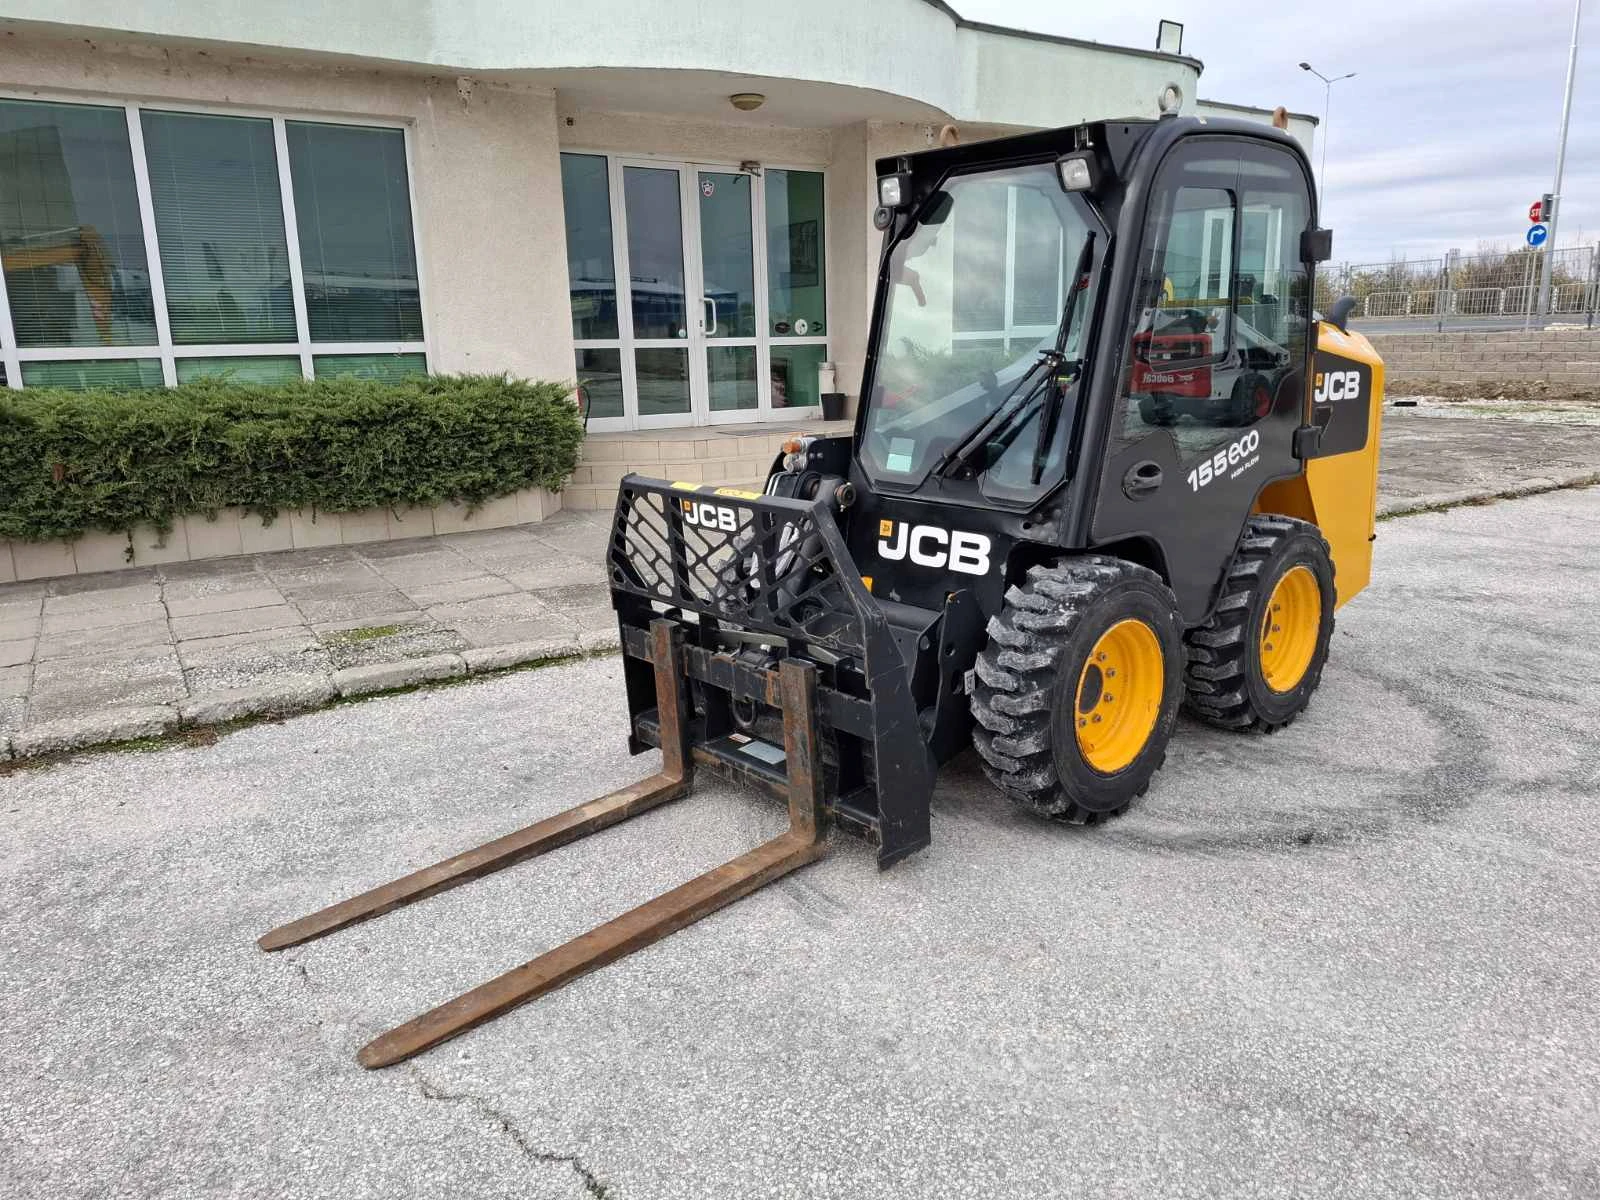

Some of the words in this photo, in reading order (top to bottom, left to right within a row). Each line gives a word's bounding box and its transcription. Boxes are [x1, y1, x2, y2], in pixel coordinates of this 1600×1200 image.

[1314, 371, 1360, 403] JCB
[684, 501, 737, 532] JCB
[877, 521, 991, 576] JCB
